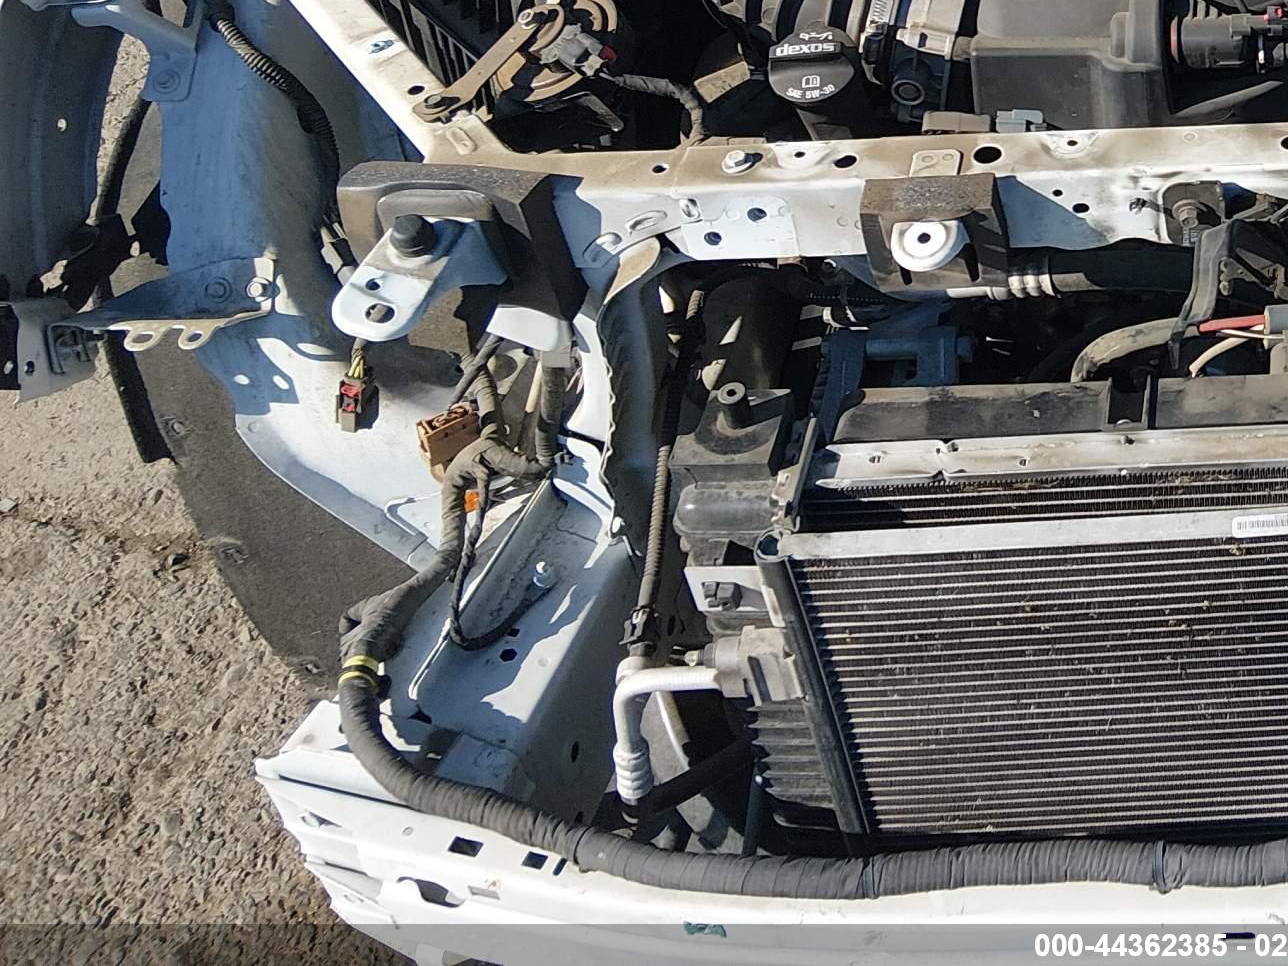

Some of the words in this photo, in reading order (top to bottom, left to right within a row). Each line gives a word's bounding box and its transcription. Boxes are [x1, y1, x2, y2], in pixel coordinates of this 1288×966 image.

[775, 42, 835, 56] dexos
[786, 88, 803, 98] SAE
[805, 85, 835, 99] 5W-30
